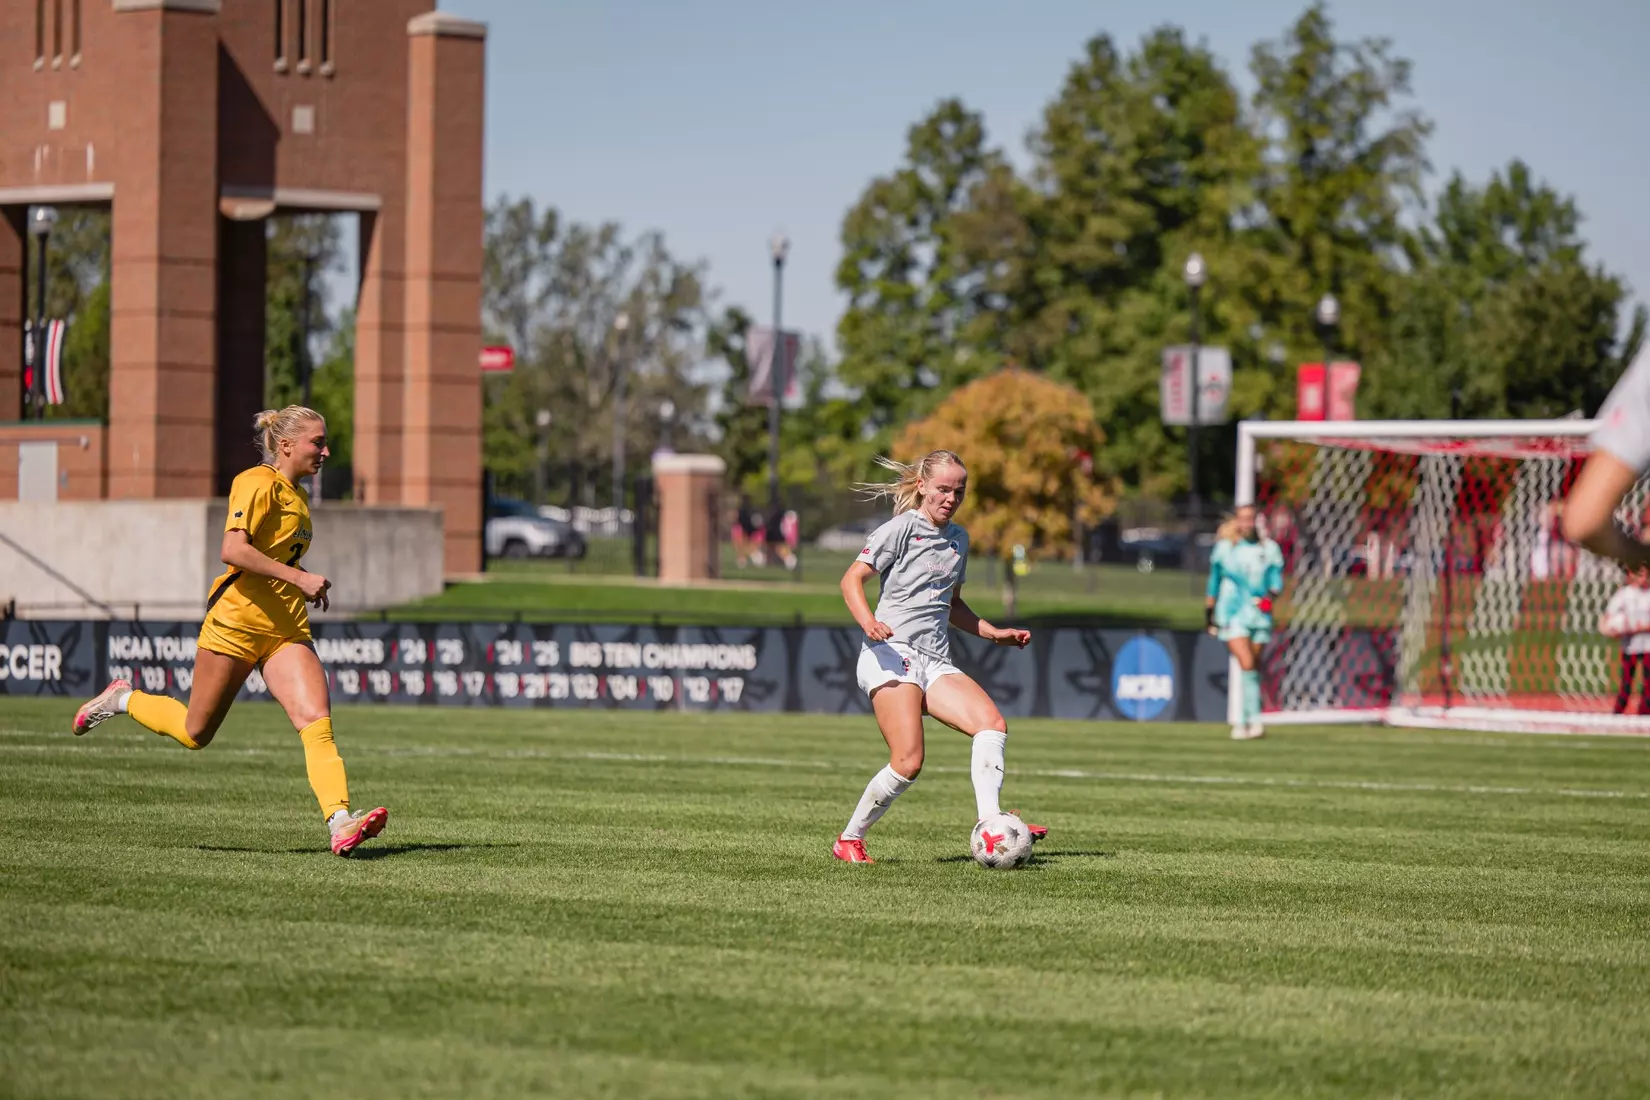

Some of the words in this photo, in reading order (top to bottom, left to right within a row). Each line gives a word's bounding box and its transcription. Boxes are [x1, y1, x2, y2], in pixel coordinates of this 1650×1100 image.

[109, 636, 153, 660] NCAA
[154, 636, 198, 661] TOUR
[569, 641, 603, 667] BIG
[603, 642, 642, 668] TEN
[643, 643, 757, 670] CHAMPIONS
[1117, 674, 1173, 700] NCAA
